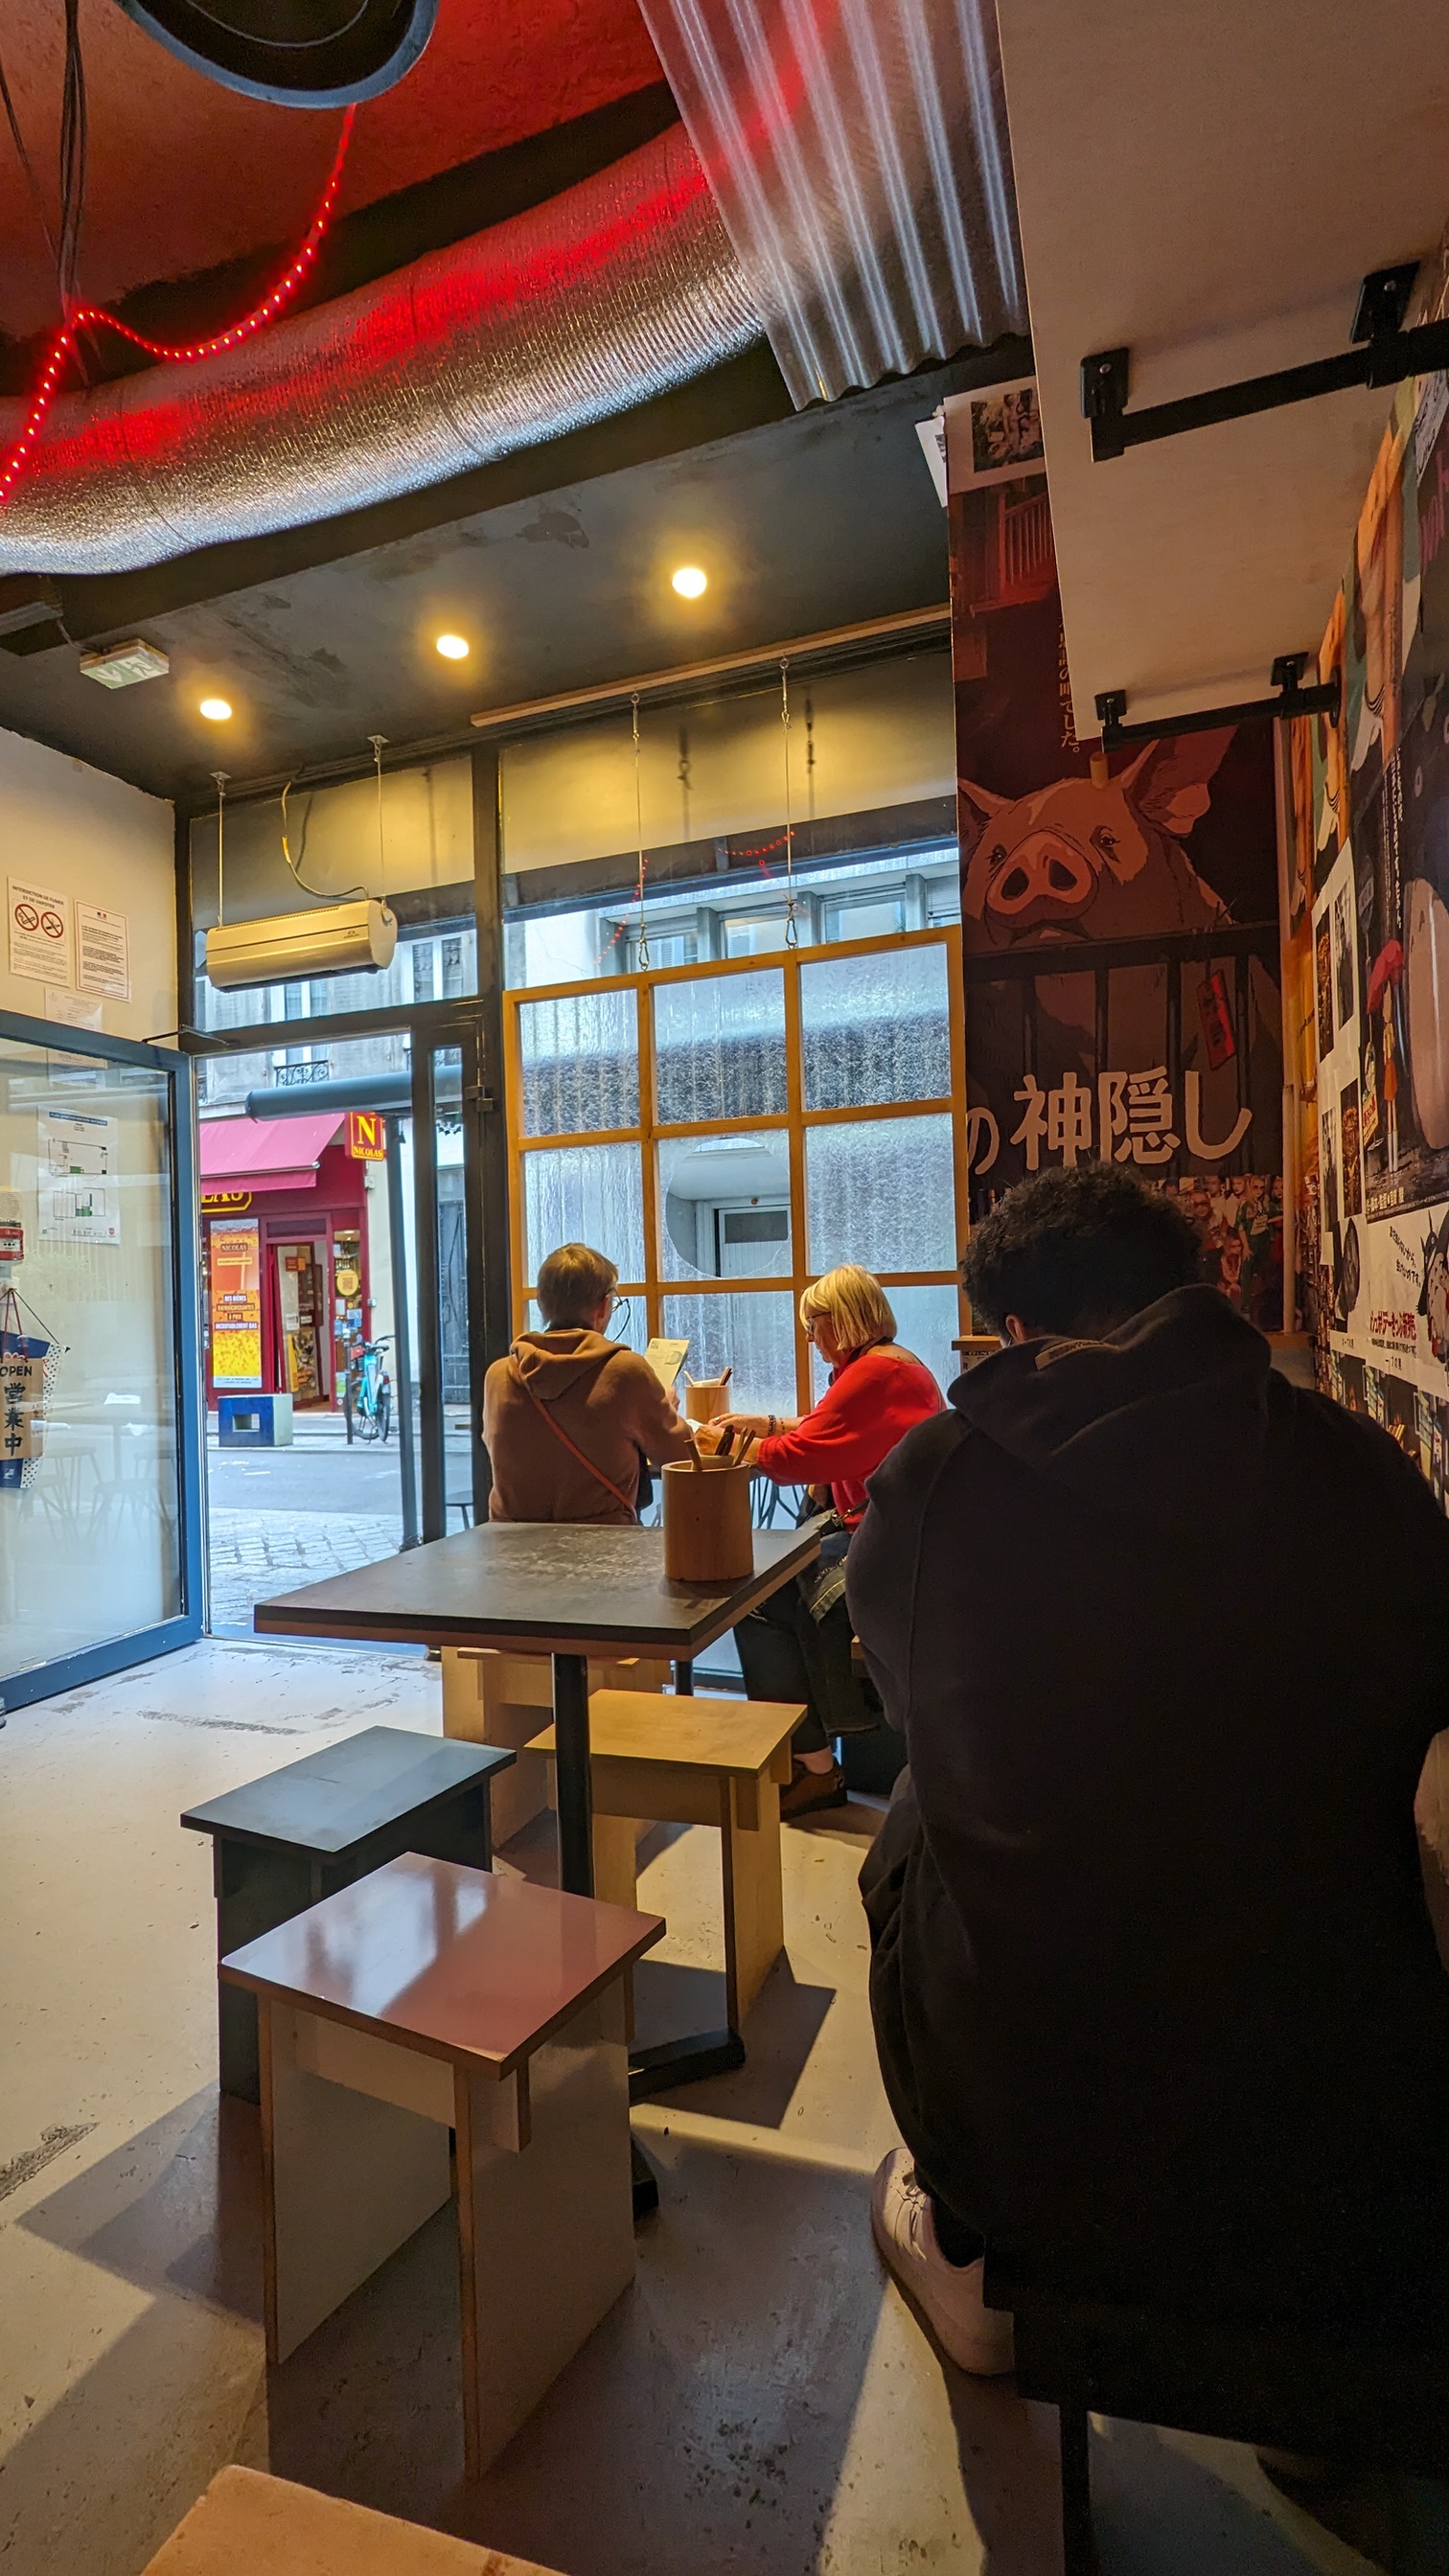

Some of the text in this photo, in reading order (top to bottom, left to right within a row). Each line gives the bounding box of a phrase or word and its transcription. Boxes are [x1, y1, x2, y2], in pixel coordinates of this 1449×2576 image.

[356, 1116, 377, 1146] N
[966, 1066, 1253, 1175] の神隠し
[353, 1145, 382, 1158] NICOLAS
[0, 1366, 33, 1377] OPEN
[4, 1382, 26, 1457] 営業中
